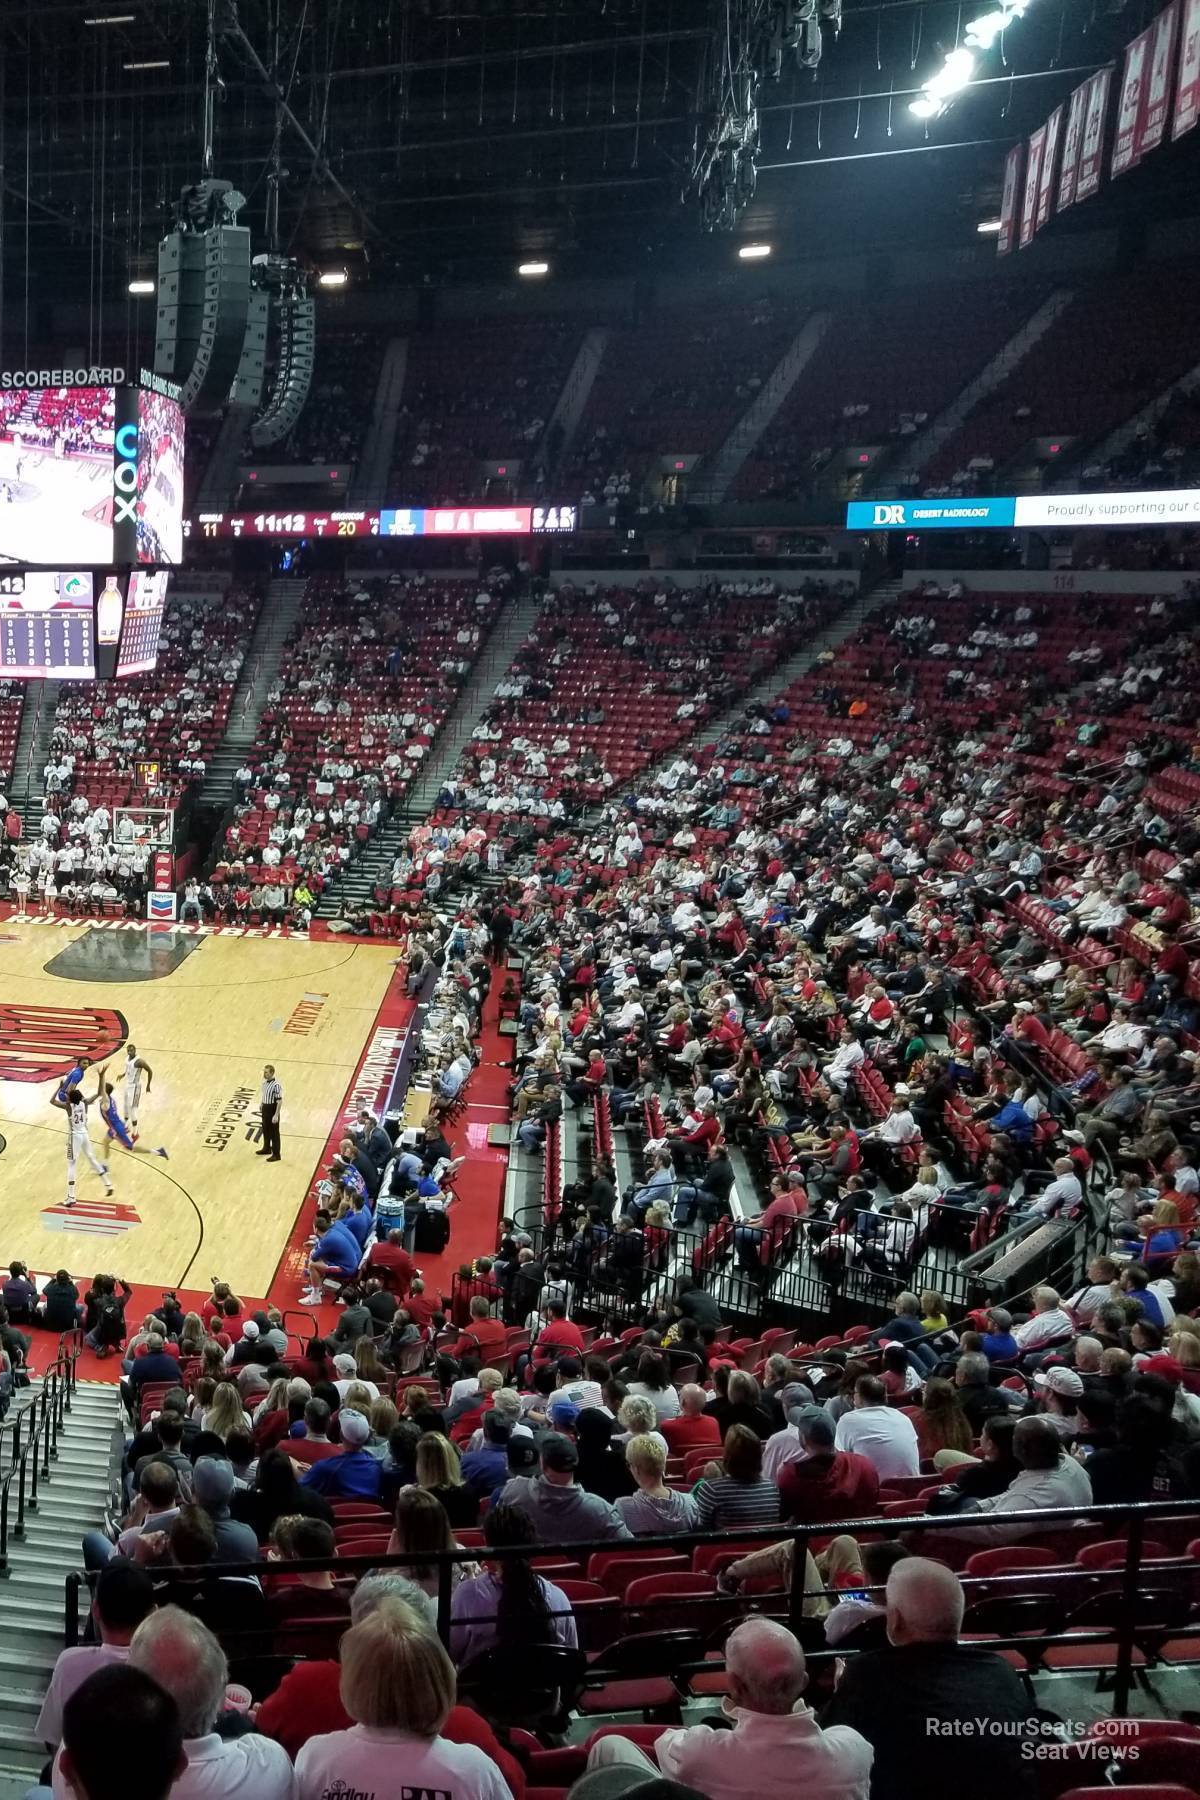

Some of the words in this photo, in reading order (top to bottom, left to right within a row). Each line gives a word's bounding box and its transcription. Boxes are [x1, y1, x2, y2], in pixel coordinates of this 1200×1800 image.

[1, 367, 125, 388] SCOREBOARD
[114, 424, 138, 523] COX
[873, 504, 906, 525] DR
[913, 508, 942, 518] DESERT
[943, 507, 989, 518] RADIOLOGY
[1047, 502, 1095, 517] Proudly
[1098, 502, 1165, 516] supporting
[1169, 503, 1189, 512] our
[203, 523, 217, 536] 11
[254, 514, 306, 532] 11:12
[338, 522, 356, 536] 20
[167, 923, 310, 940] REBELS
[216, 1086, 257, 1123] AMERICA
[74, 1114, 84, 1124] 24
[201, 1123, 236, 1152] FIRST
